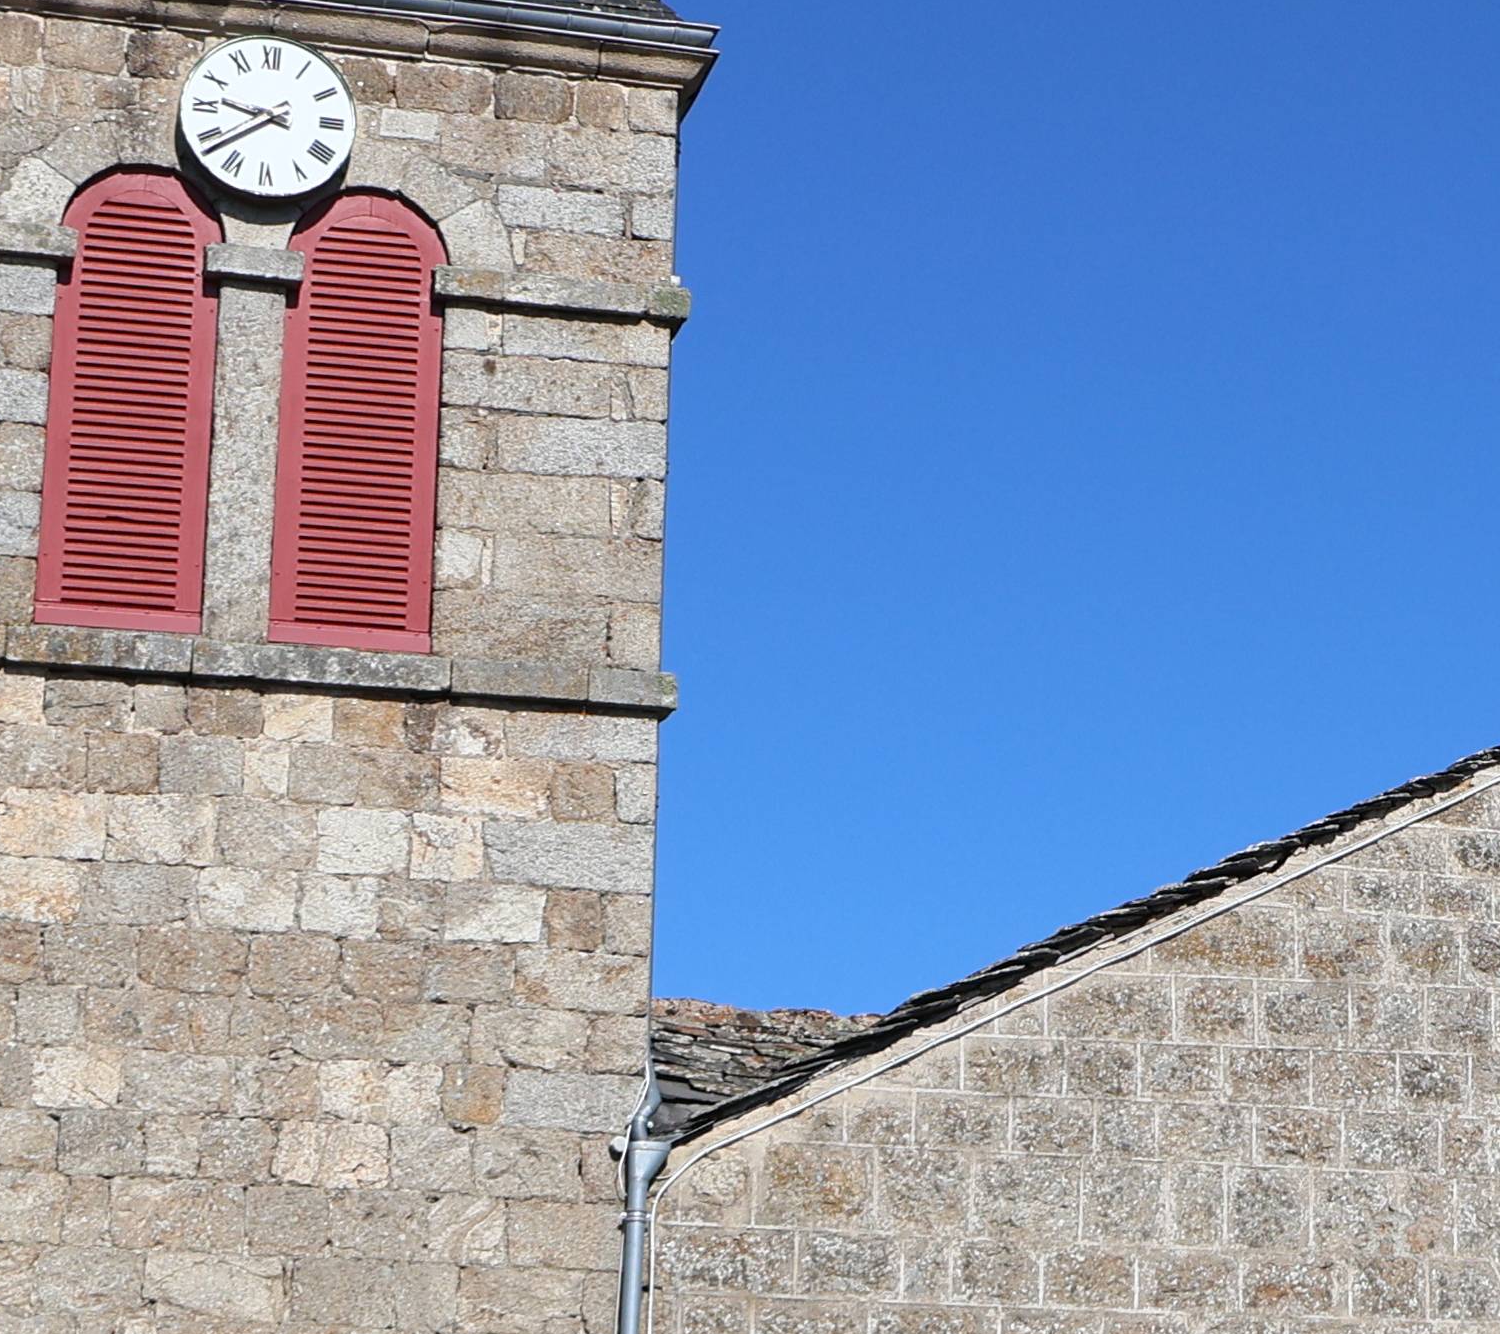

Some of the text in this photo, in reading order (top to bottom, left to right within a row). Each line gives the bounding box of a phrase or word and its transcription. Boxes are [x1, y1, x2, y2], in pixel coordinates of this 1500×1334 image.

[228, 49, 252, 76] XI
[261, 45, 282, 71] XII
[203, 70, 229, 92] X
[192, 97, 219, 114] IX
[313, 87, 338, 102] II
[319, 116, 345, 131] III
[220, 149, 246, 178] VII
[306, 139, 336, 165] IIII
[258, 161, 274, 187] VI
[291, 158, 308, 183] V
